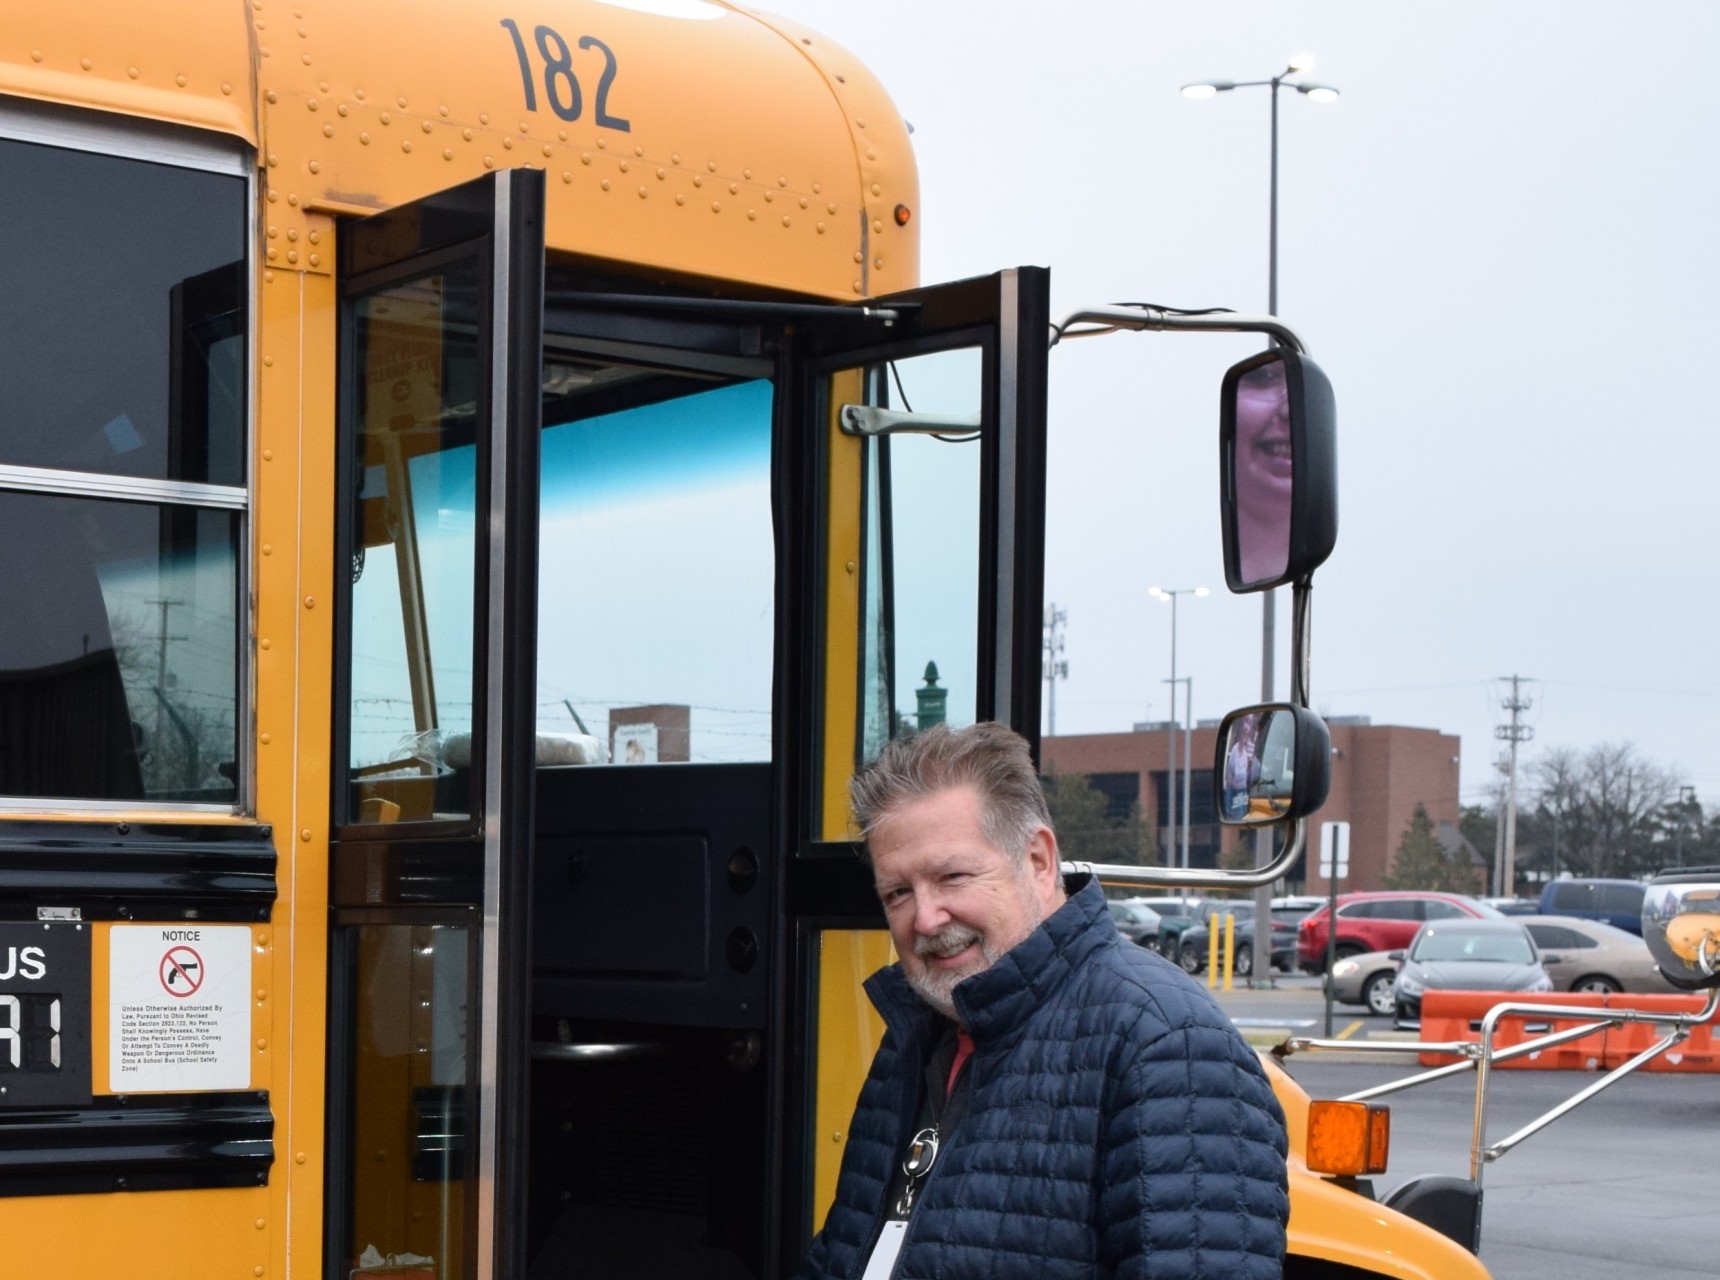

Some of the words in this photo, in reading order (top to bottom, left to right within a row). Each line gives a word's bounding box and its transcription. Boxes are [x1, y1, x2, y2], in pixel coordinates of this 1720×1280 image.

[500, 18, 631, 133] 182
[162, 930, 201, 942] NOTICE
[214, 1005, 223, 1013] By
